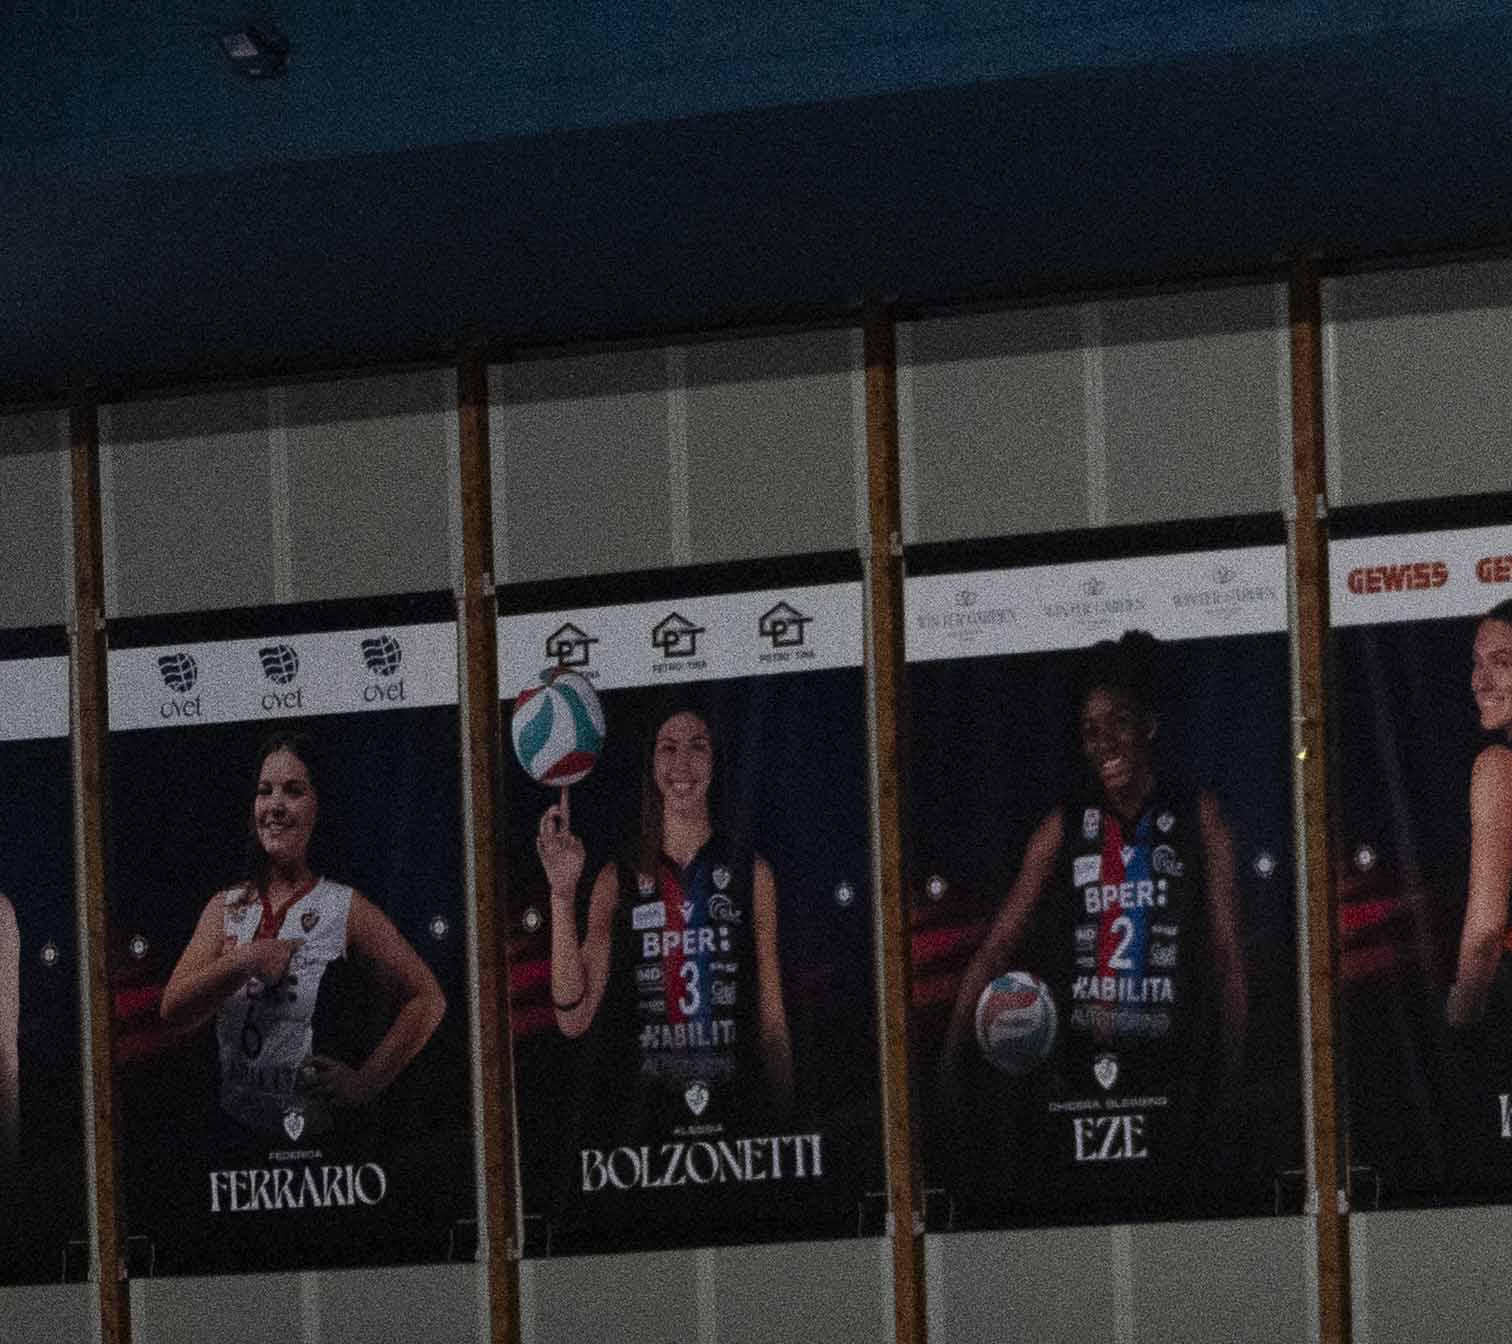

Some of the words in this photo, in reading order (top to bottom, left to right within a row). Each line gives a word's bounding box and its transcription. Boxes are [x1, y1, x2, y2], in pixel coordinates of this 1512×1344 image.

[1107, 915, 1136, 970] 2
[678, 960, 701, 1015] 3
[580, 1133, 824, 1192] BOLZONETTI
[1072, 1114, 1148, 1162] EZE
[210, 1162, 388, 1214] FERRARIO
